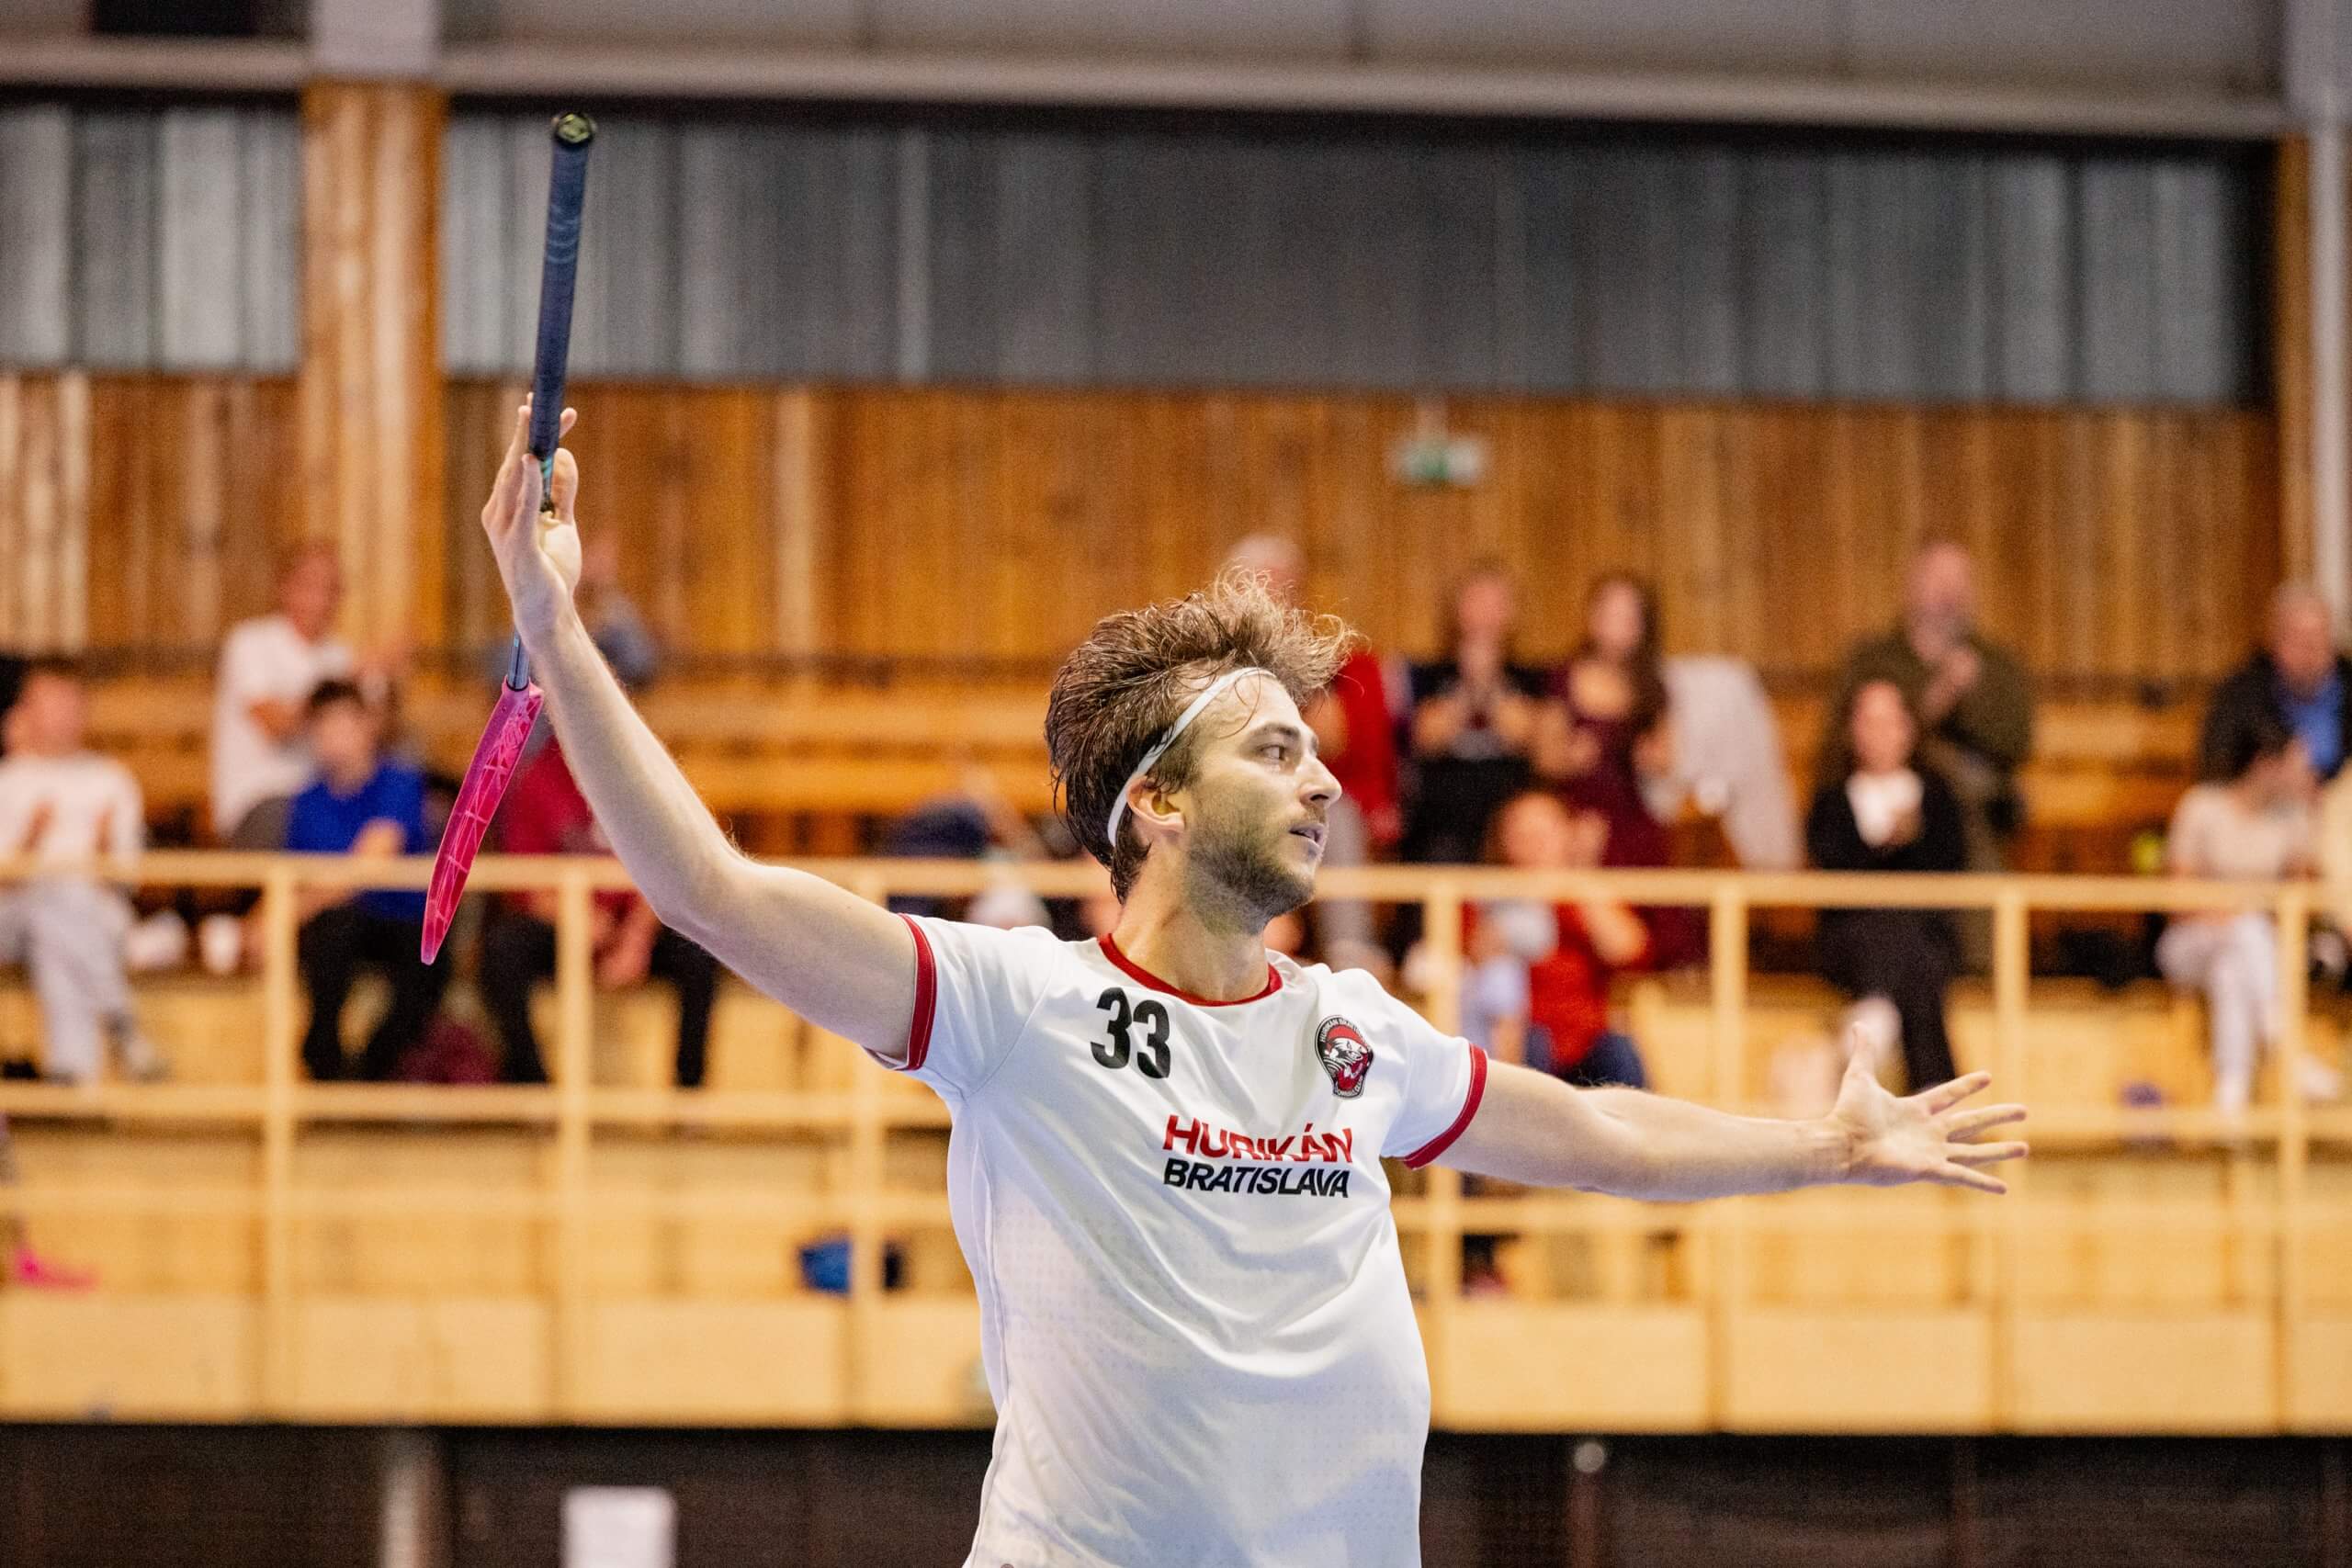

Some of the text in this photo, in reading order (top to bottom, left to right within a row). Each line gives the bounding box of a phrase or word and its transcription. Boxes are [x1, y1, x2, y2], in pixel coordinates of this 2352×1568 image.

[1091, 987, 1171, 1079] 33
[1162, 1114, 1353, 1164] HURIKÁN
[1163, 1157, 1351, 1199] BRATISLAVA
